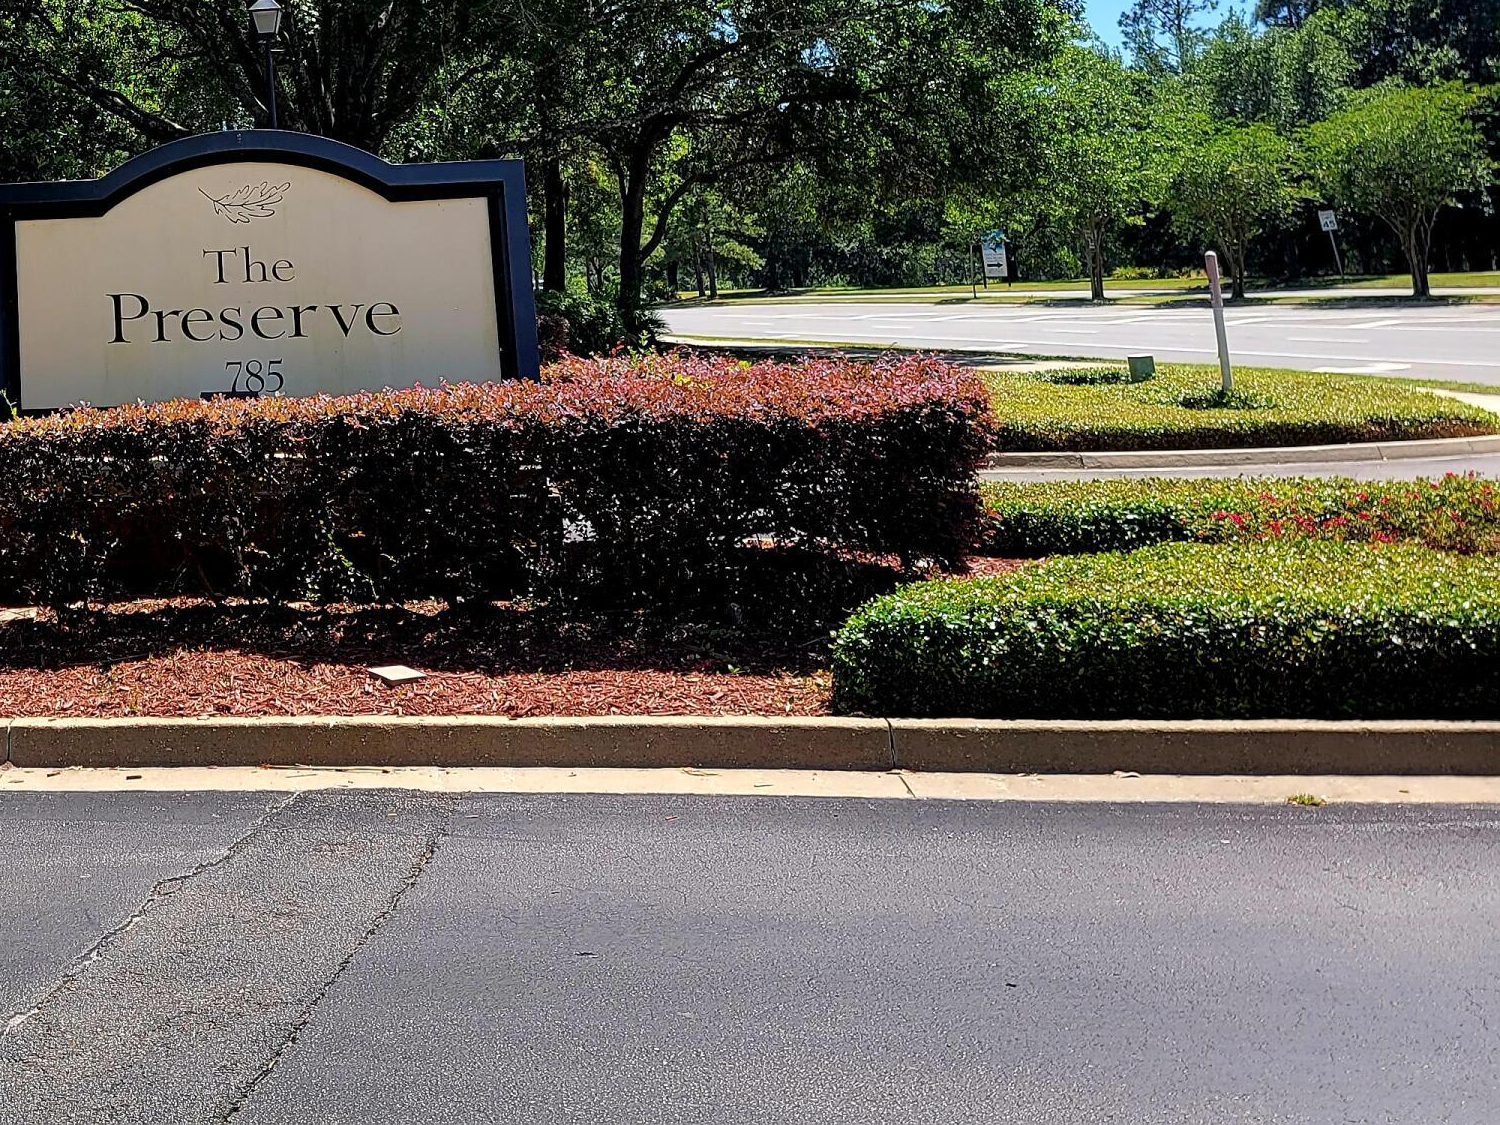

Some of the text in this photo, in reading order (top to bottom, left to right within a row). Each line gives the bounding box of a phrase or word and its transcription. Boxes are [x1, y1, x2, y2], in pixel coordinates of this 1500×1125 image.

[202, 246, 295, 284] The
[106, 293, 402, 344] Preserve
[225, 358, 284, 393] 785
